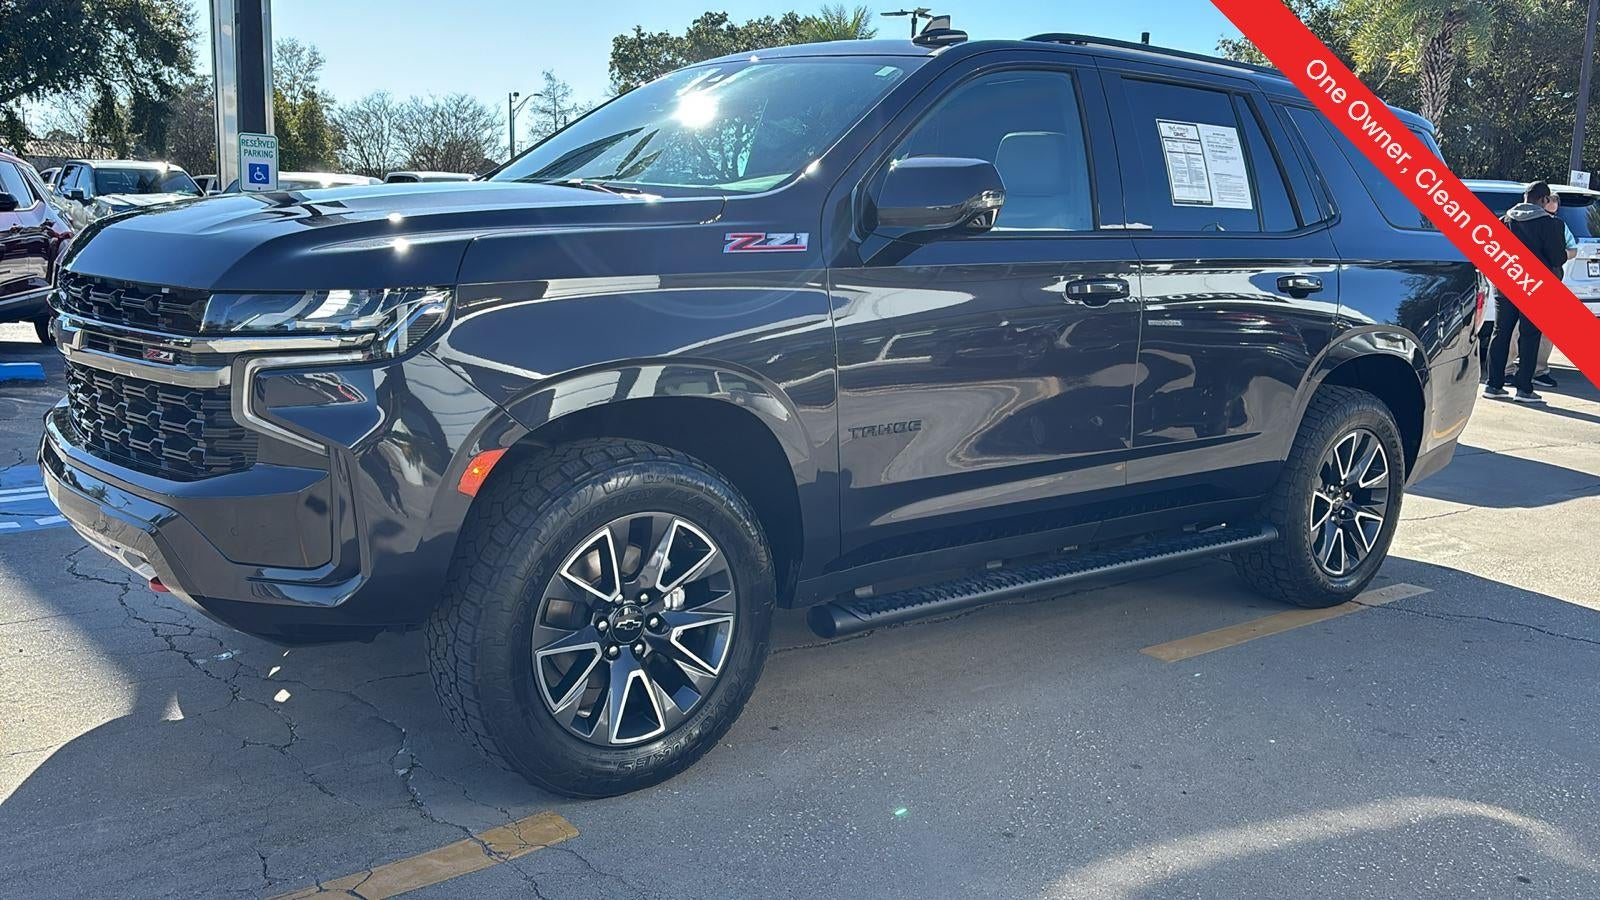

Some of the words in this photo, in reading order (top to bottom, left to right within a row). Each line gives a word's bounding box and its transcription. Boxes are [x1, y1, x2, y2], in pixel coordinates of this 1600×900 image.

[241, 139, 276, 149] RESERVED
[243, 149, 274, 158] PARKING
[723, 233, 809, 253] Z71
[848, 419, 922, 440] TAHOE
